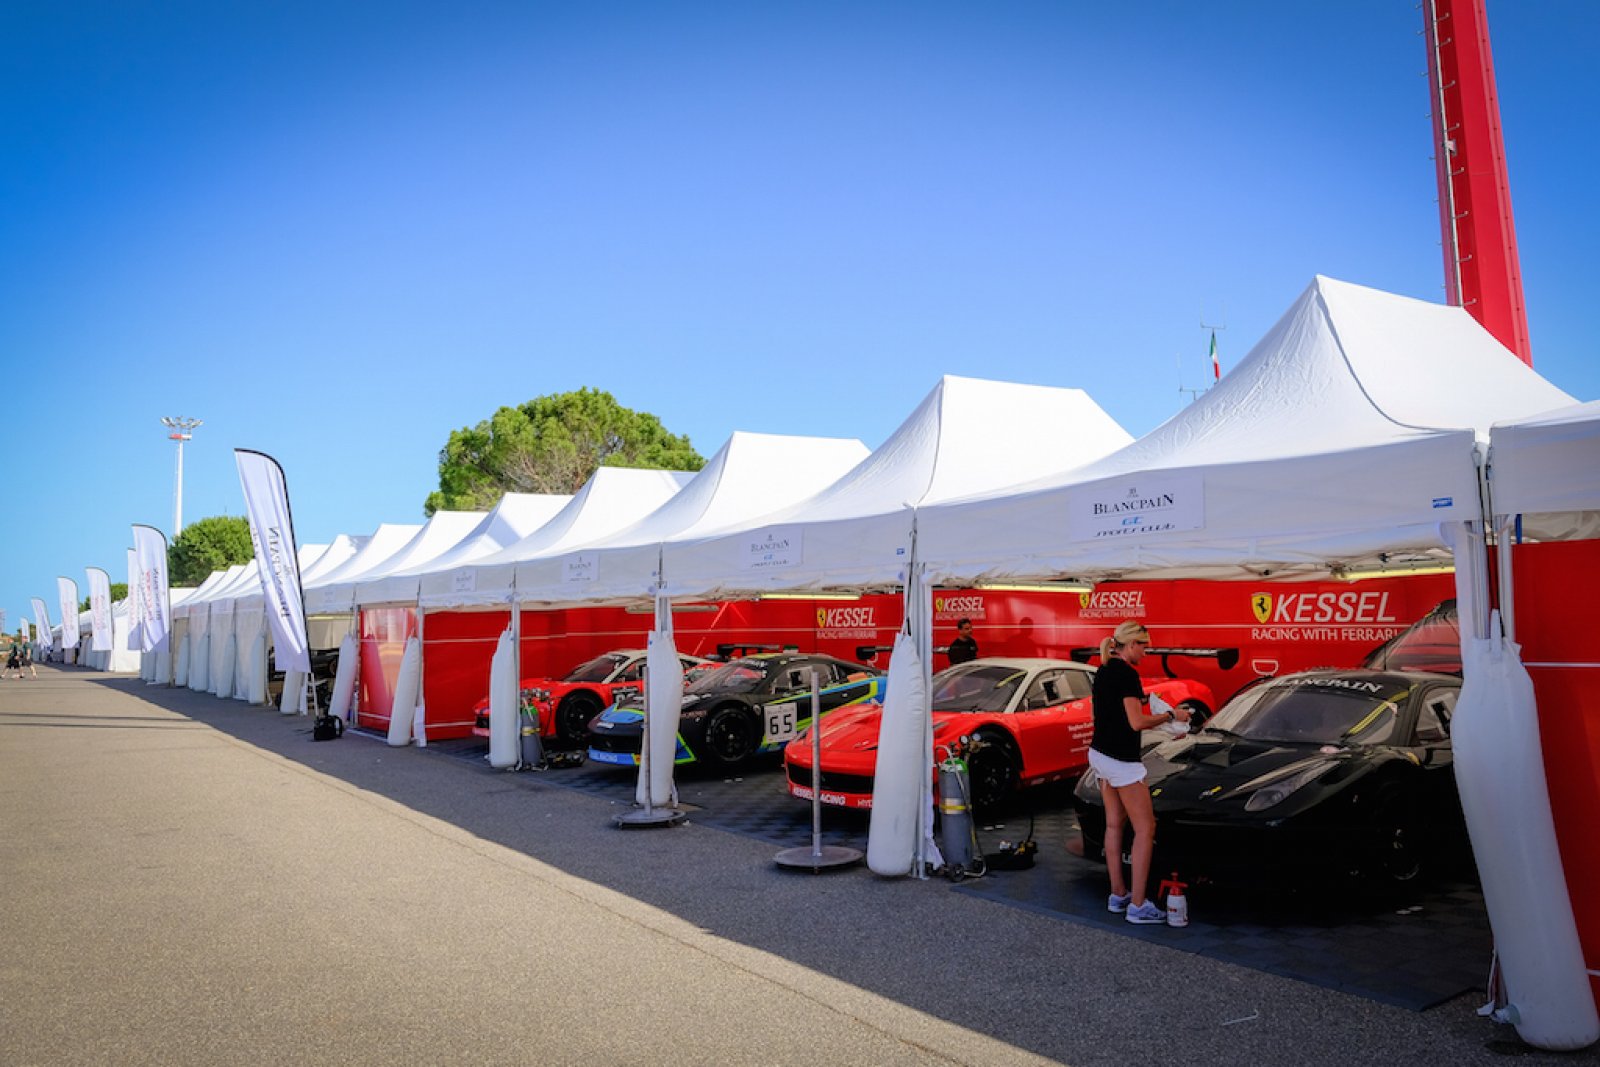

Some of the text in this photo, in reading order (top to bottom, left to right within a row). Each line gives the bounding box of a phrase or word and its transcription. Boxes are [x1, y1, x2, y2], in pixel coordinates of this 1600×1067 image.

[1093, 493, 1175, 515] BLANCPAIN
[943, 596, 985, 612] KESSEL
[1089, 591, 1145, 608] KESSEL
[1273, 591, 1396, 623] KESSEL
[826, 607, 876, 628] KESSEL
[1251, 628, 1300, 641] RACING
[1301, 628, 1338, 641] WITH
[770, 714, 792, 735] 65
[816, 792, 846, 806] ACING
